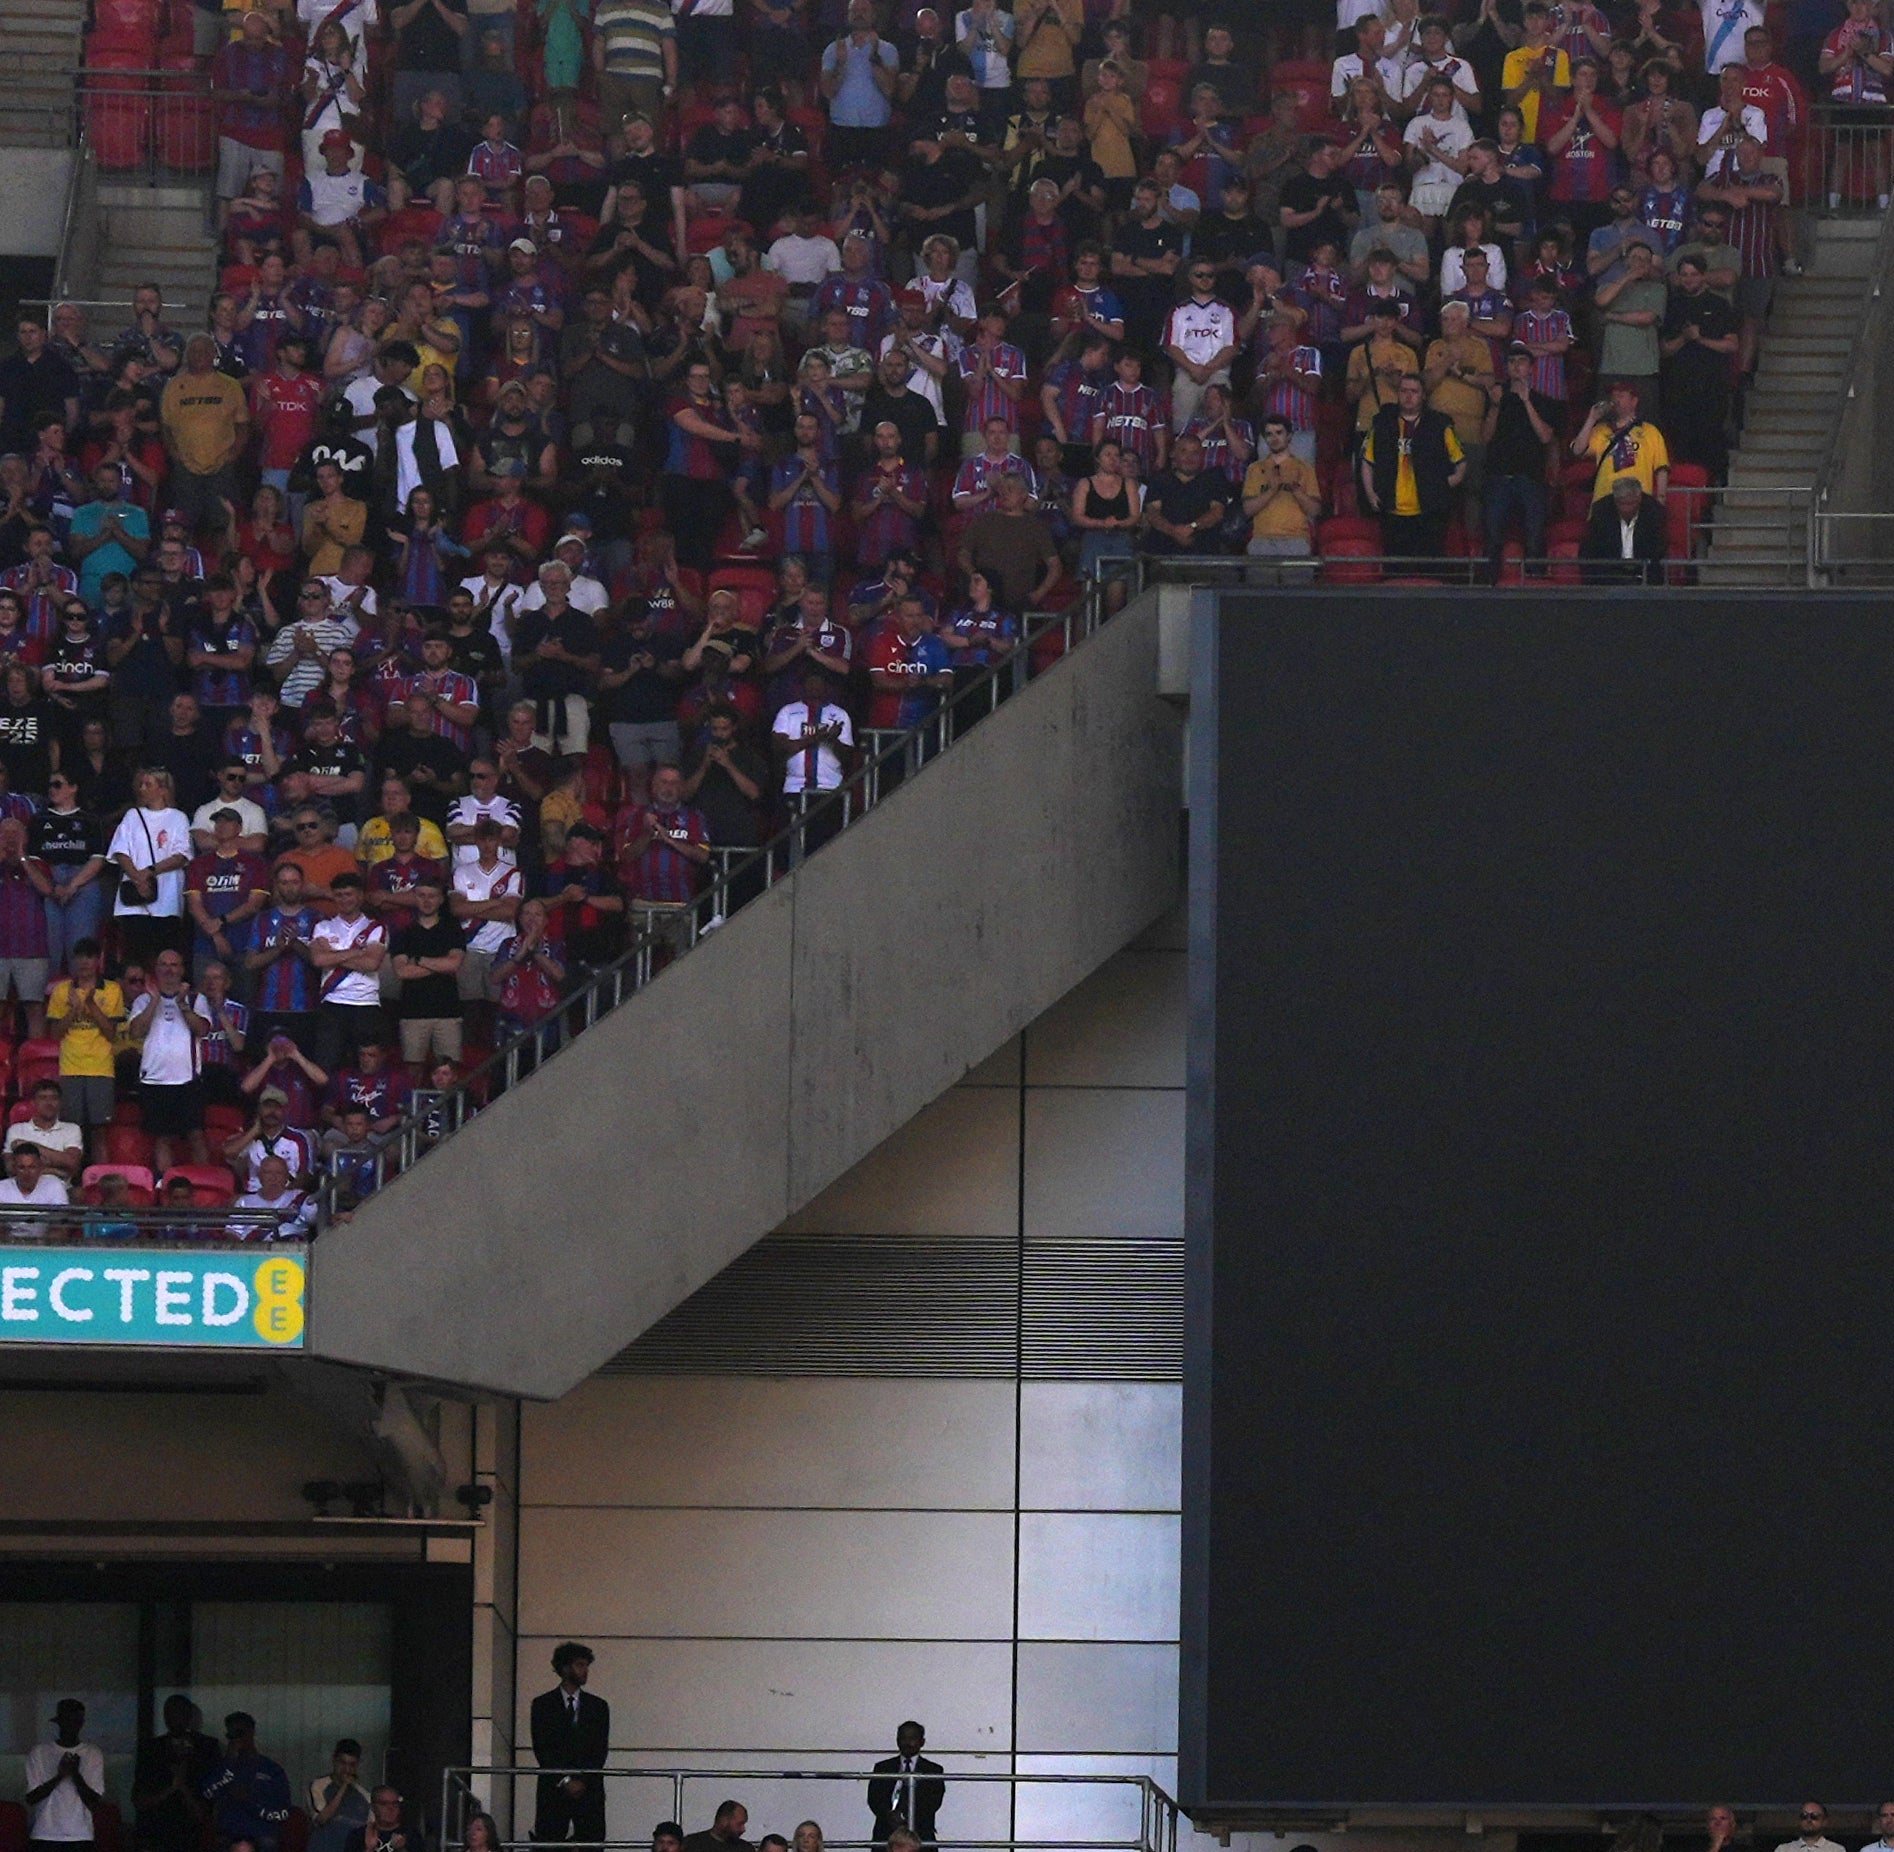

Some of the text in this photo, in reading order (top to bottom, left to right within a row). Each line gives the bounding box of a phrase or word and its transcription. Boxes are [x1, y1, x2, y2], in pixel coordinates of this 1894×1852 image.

[1191, 327, 1219, 339] TDK
[277, 400, 309, 412] TDK
[580, 455, 623, 467] adidas
